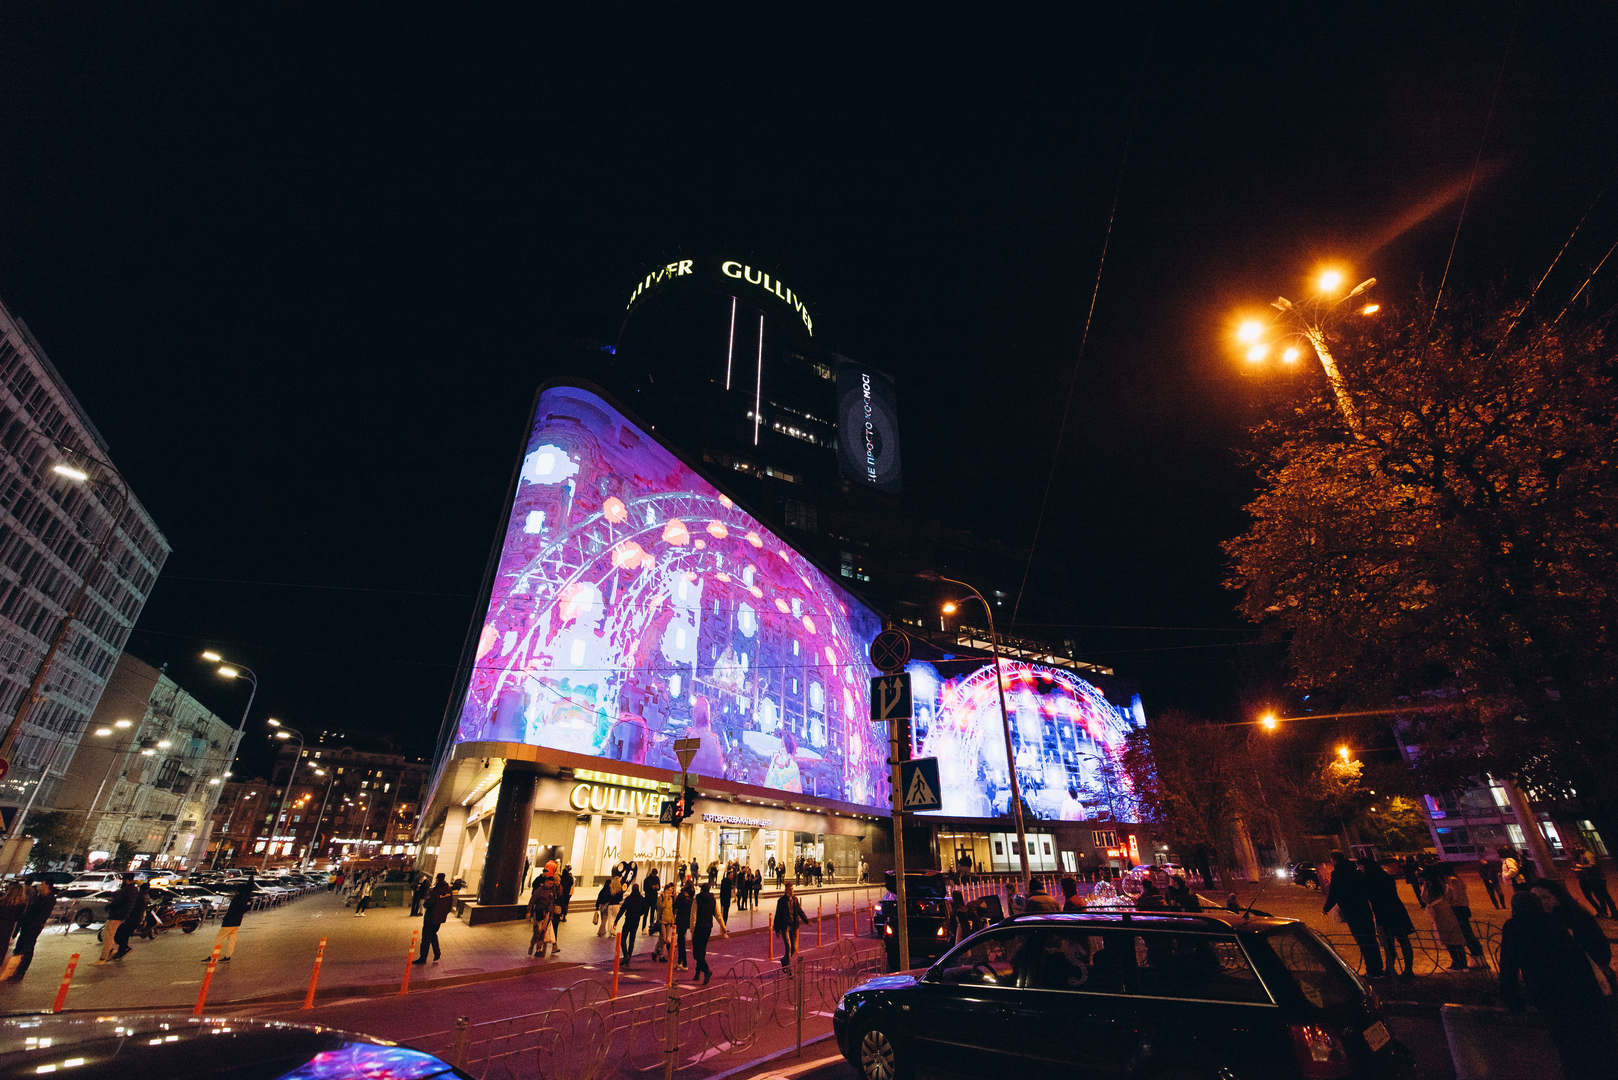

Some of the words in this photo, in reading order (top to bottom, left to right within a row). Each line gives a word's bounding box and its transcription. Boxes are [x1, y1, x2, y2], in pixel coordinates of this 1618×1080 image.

[721, 260, 813, 337] GULLIVER
[861, 373, 872, 419] КОСМОС!
[864, 421, 875, 465] ПРОСТО
[603, 845, 653, 859] Mimo
[654, 846, 682, 860] Dut
